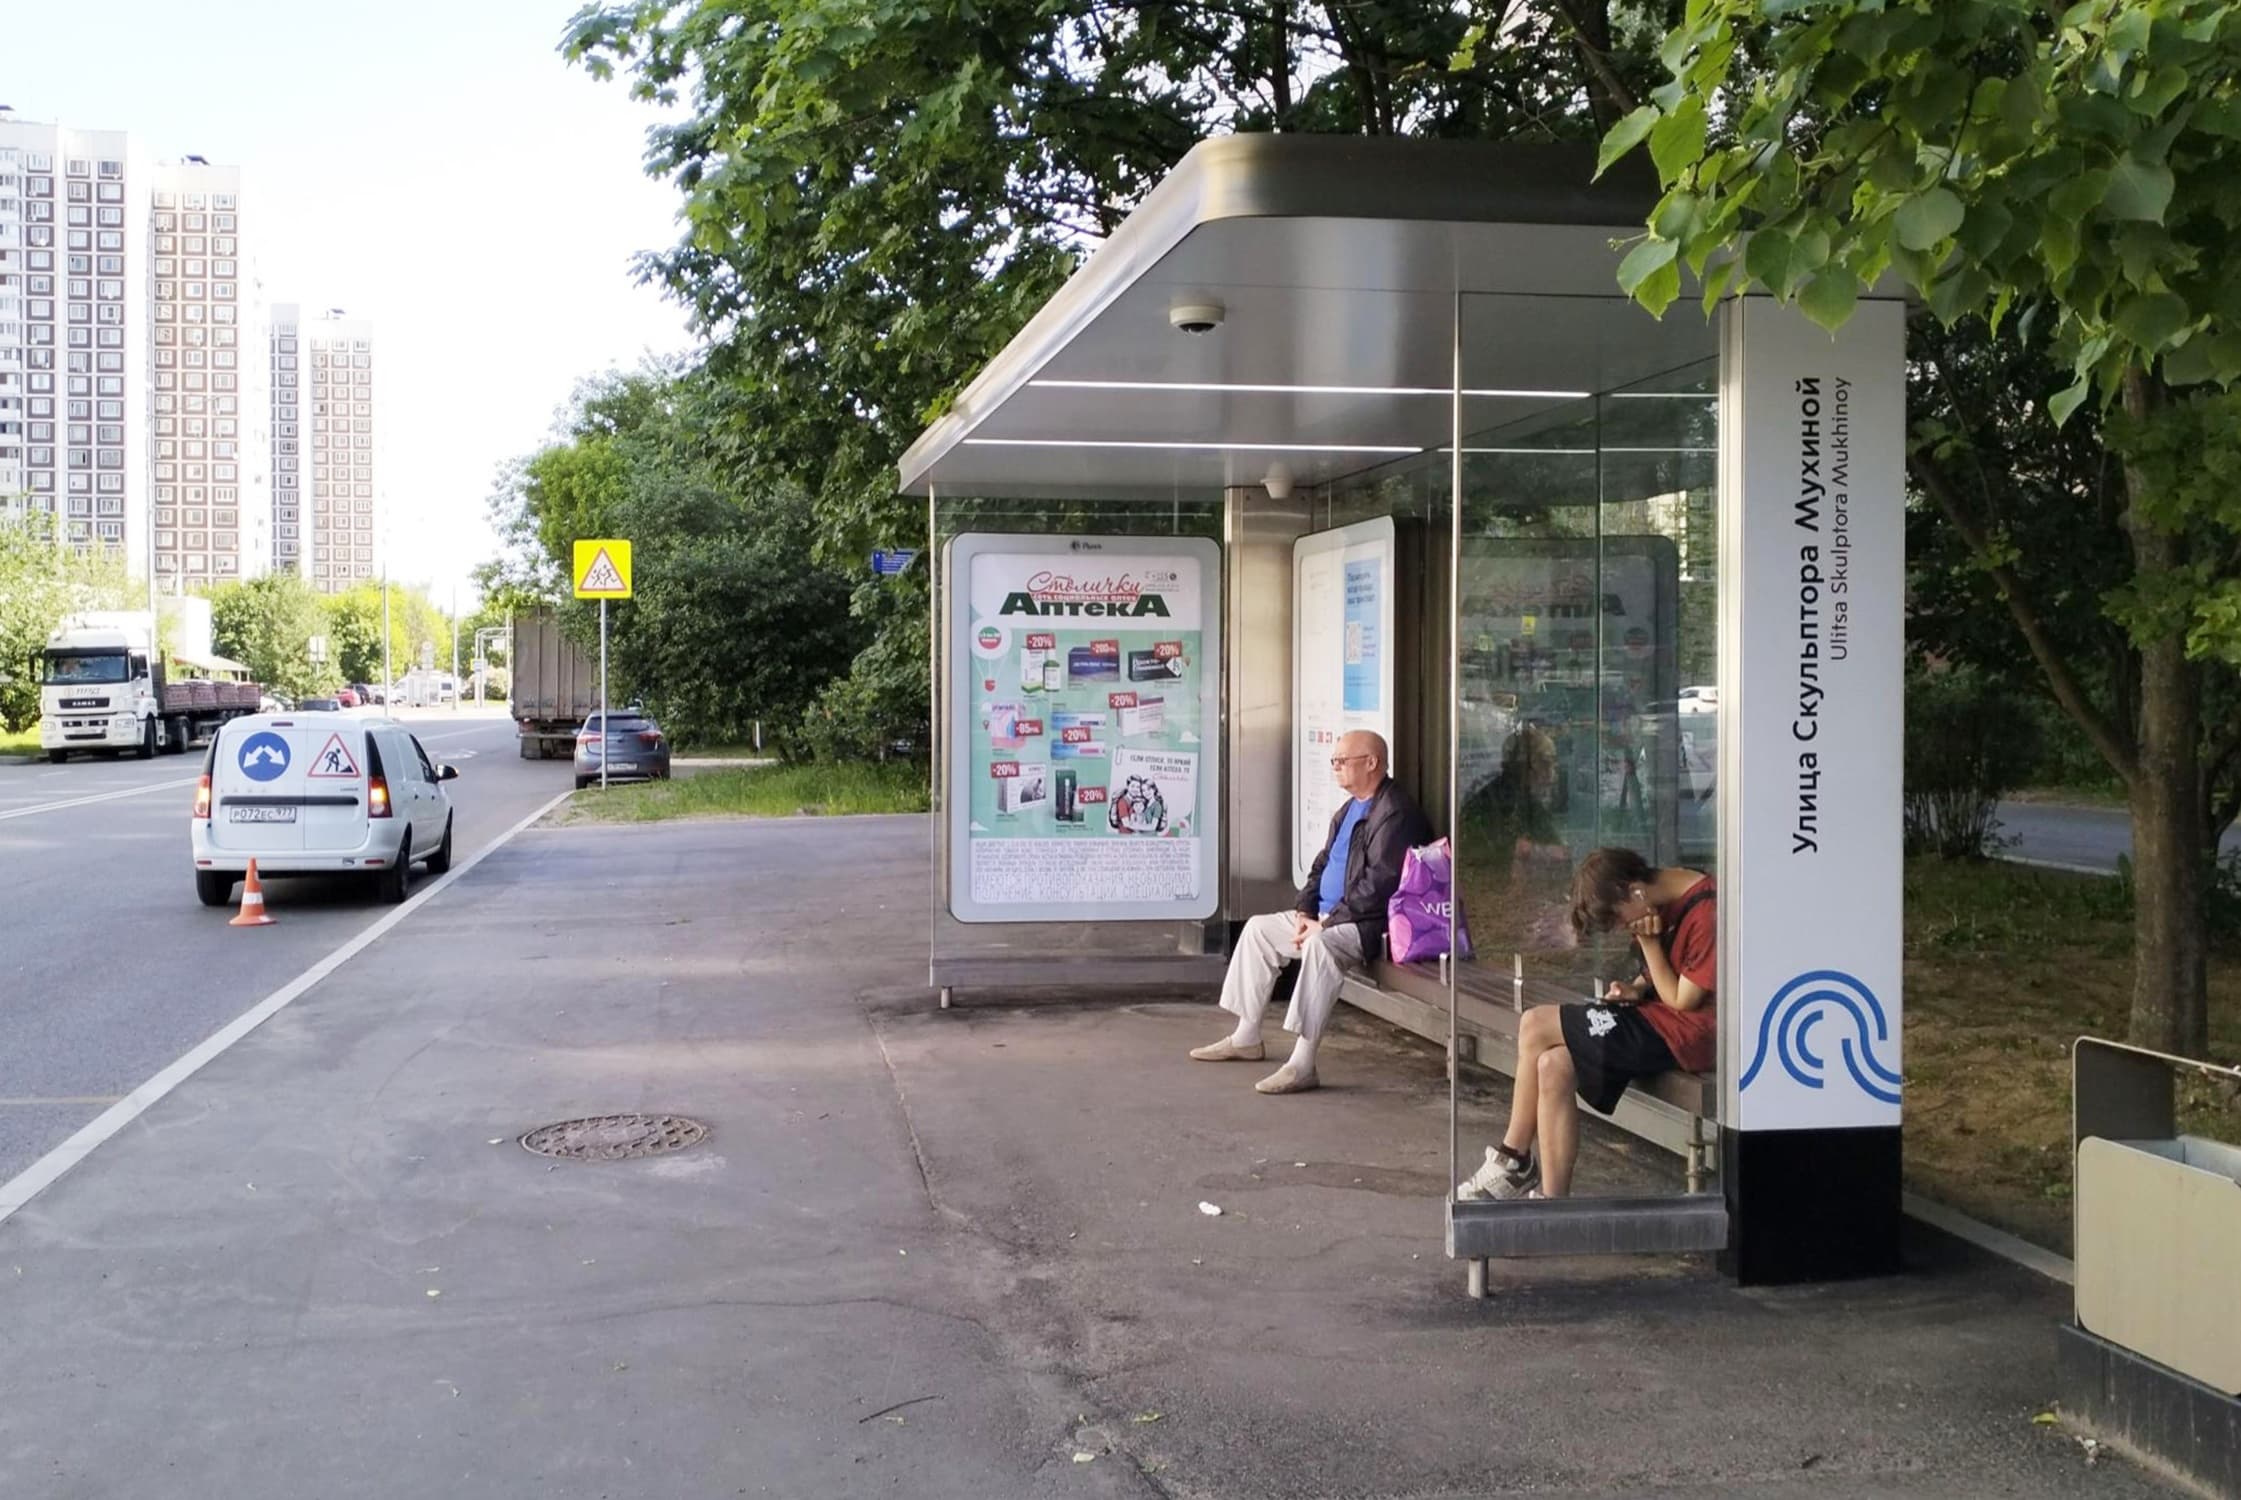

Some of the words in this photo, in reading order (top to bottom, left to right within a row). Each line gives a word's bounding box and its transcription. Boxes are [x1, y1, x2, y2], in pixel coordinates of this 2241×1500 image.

[1832, 376, 1852, 487] Mukhinoy
[1794, 377, 1827, 532] Мухиной
[1831, 493, 1852, 594] Skulptora
[1026, 571, 1142, 594] Столички
[1028, 634, 1053, 648] -20%
[1831, 601, 1849, 661] Ulitsa
[1156, 643, 1180, 656] -20%
[1792, 545, 1825, 742] Скульптора
[1111, 694, 1135, 707] -20%
[1063, 729, 1088, 742] -20%
[992, 763, 1017, 777] -20%
[1079, 789, 1104, 802] -20%
[1792, 752, 1822, 855] Улица
